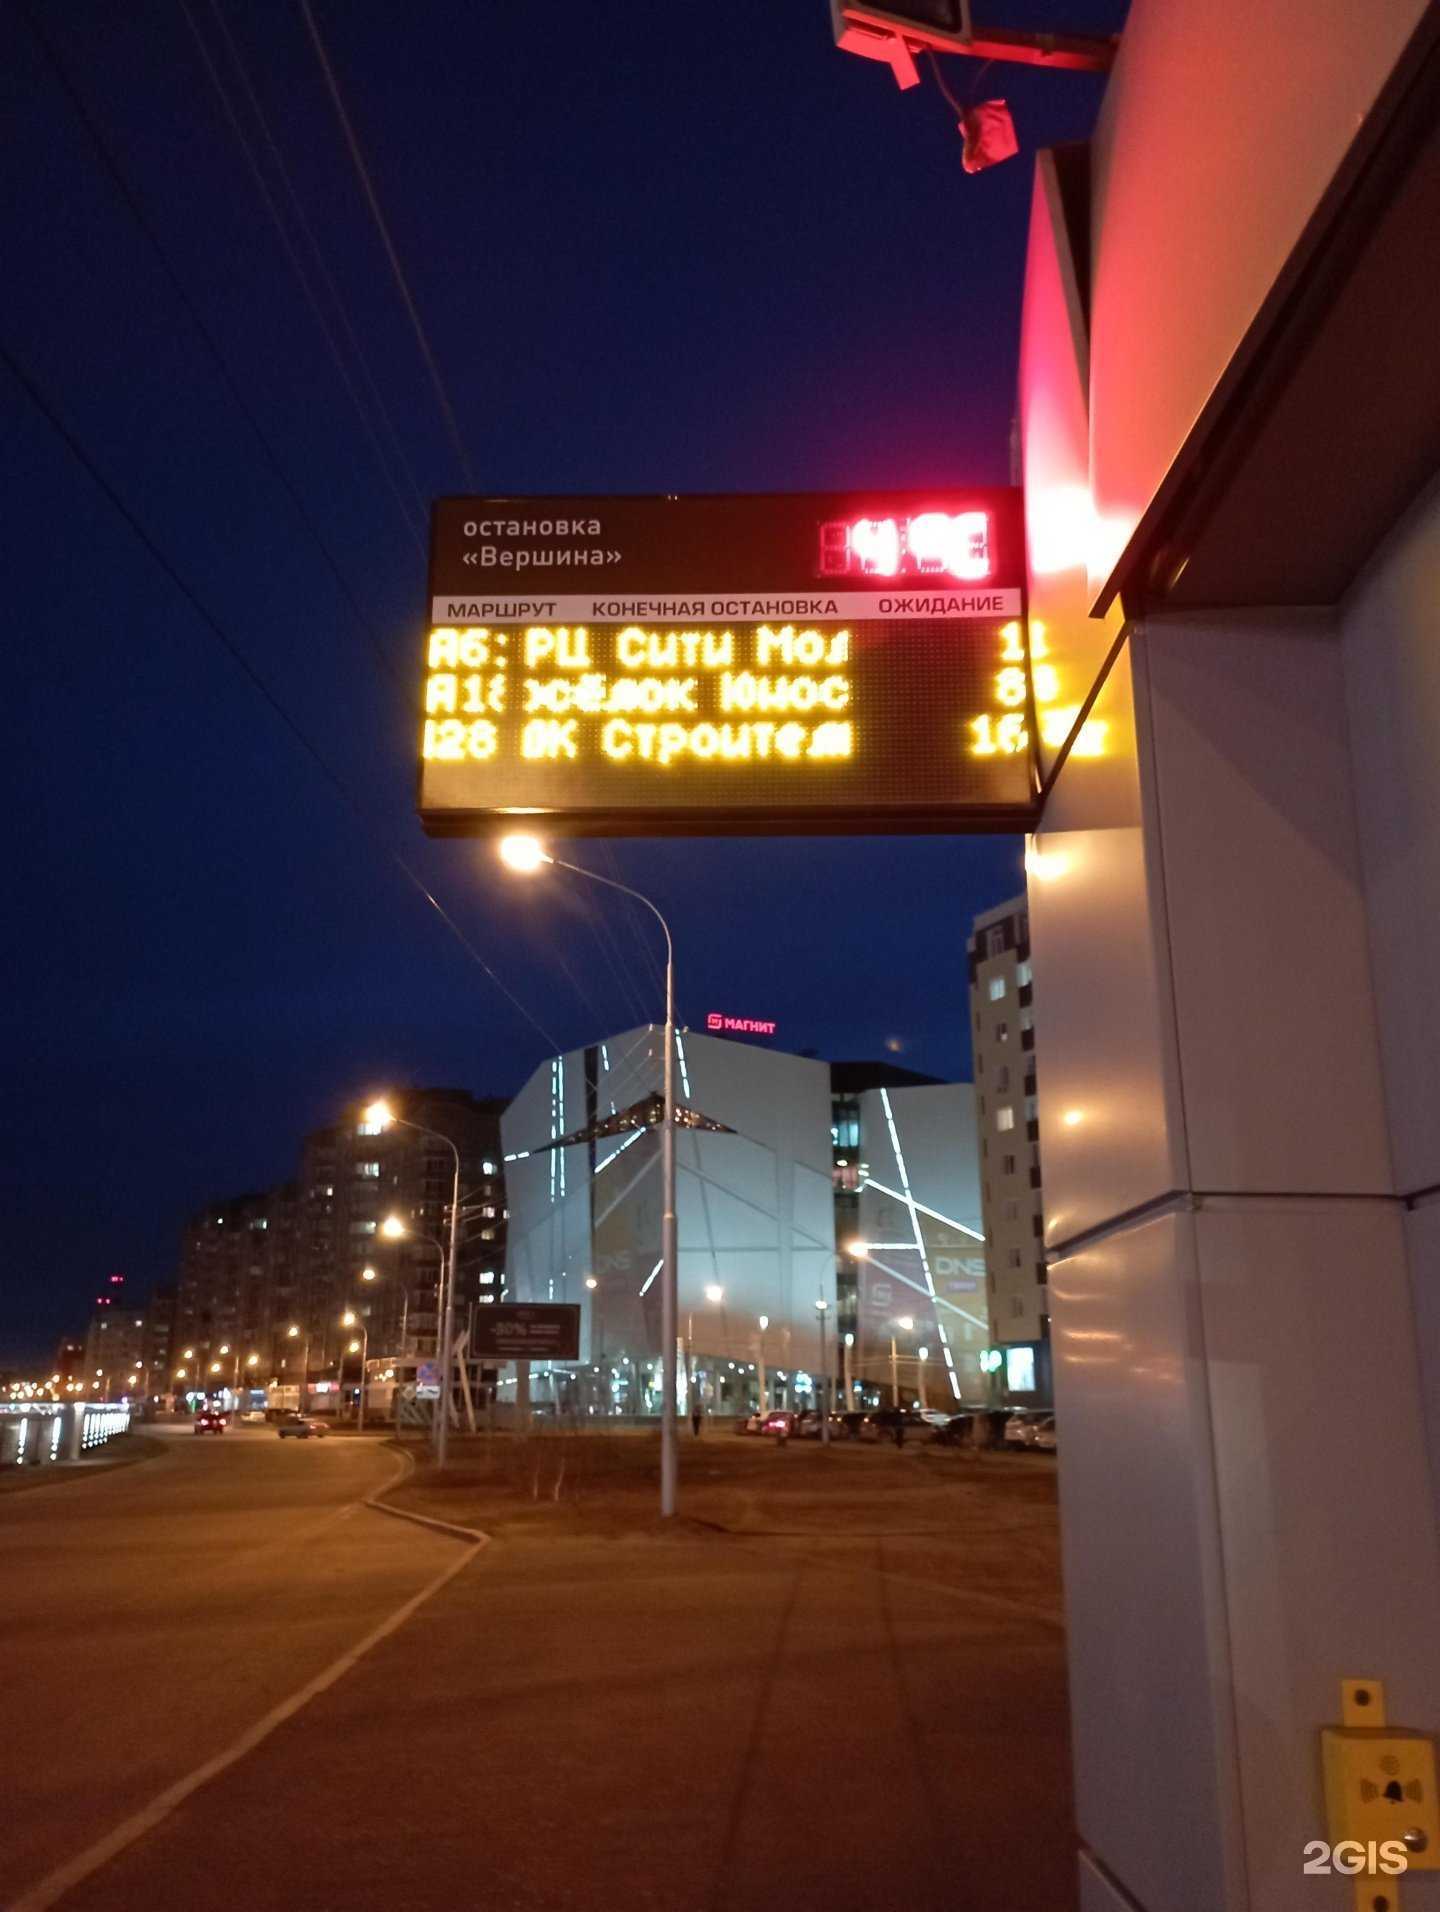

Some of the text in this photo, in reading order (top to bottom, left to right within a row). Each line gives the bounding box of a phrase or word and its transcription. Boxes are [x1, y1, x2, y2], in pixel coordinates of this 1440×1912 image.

[463, 518, 602, 537] остановка
[462, 546, 622, 570] «Вершина»
[447, 596, 1004, 618] МАРШРУТ КОНЕЧНАЯ ОСТАНОВКА ОЖИДАНИЕ
[617, 627, 733, 667] Сити
[725, 1018, 776, 1034] МАГНИТ
